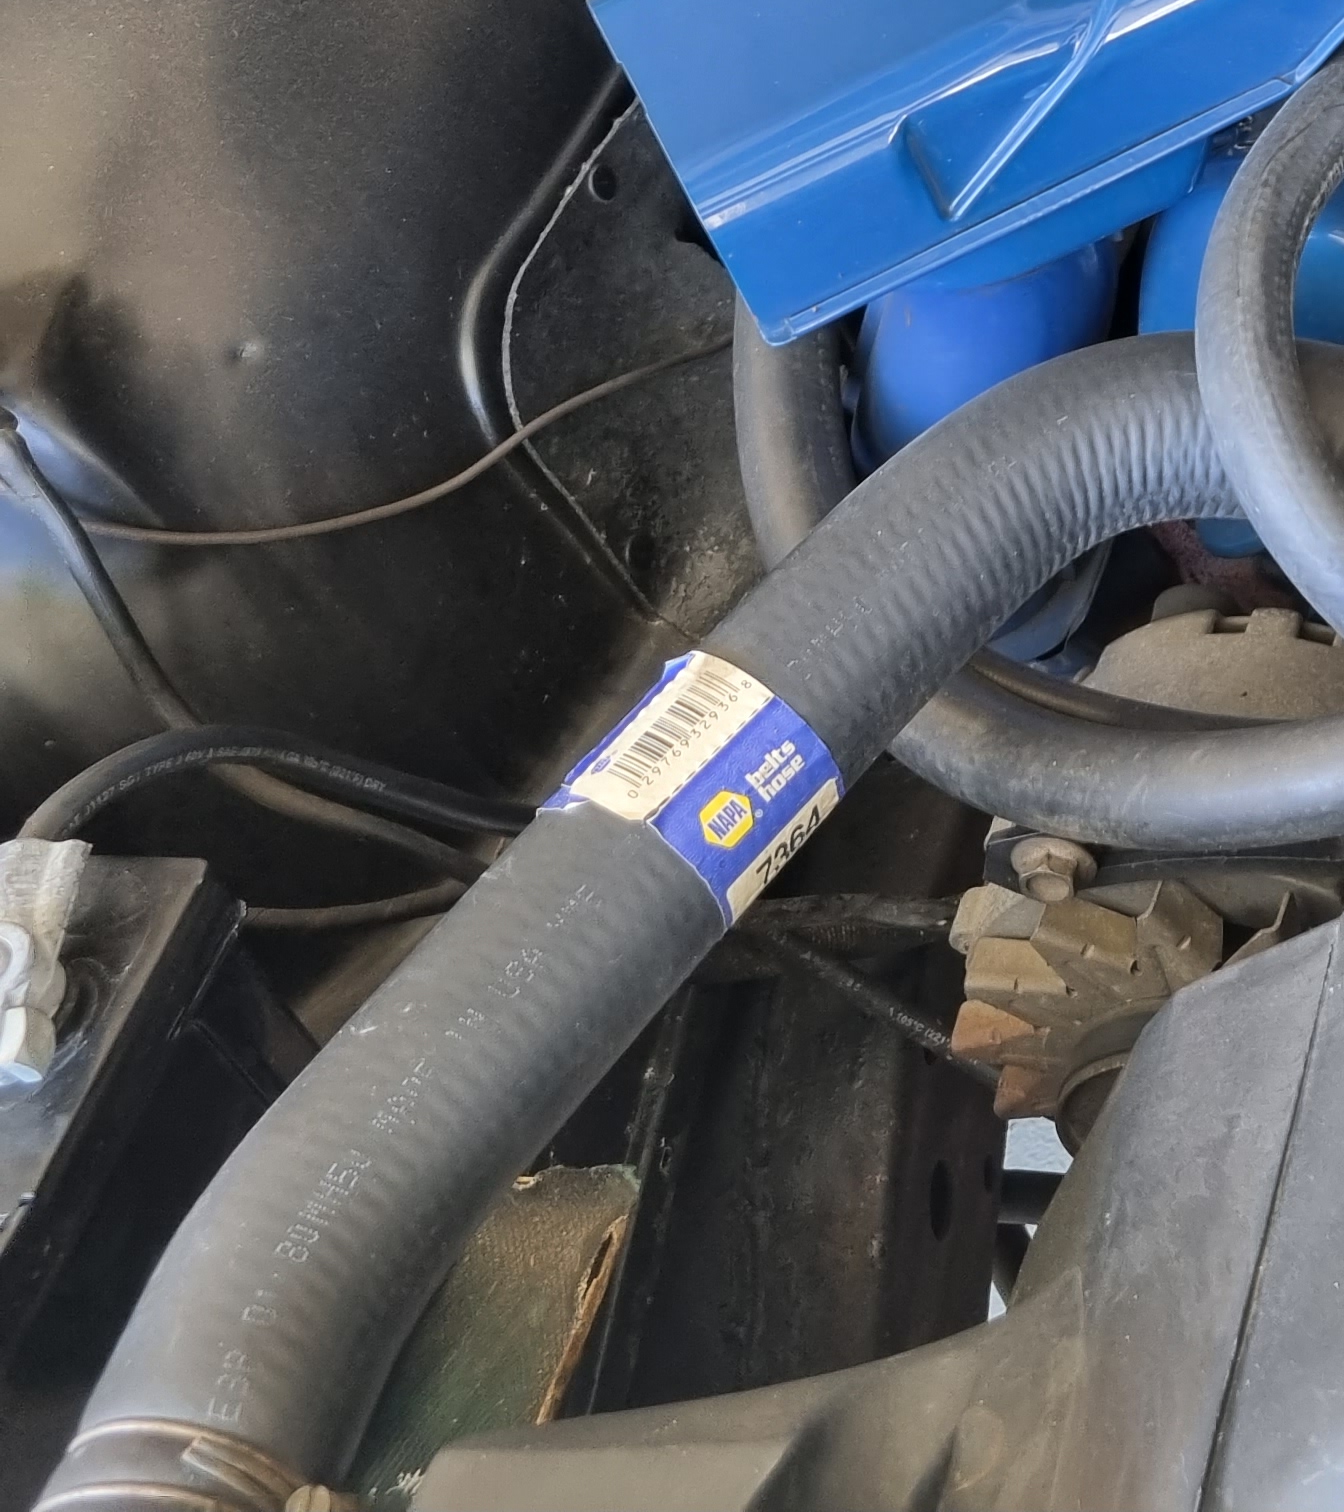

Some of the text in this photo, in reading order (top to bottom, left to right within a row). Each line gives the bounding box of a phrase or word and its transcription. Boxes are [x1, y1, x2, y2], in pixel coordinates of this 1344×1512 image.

[744, 739, 796, 787] belts
[757, 754, 806, 803] hose
[707, 799, 748, 840] NAPA
[755, 805, 823, 887] 7364
